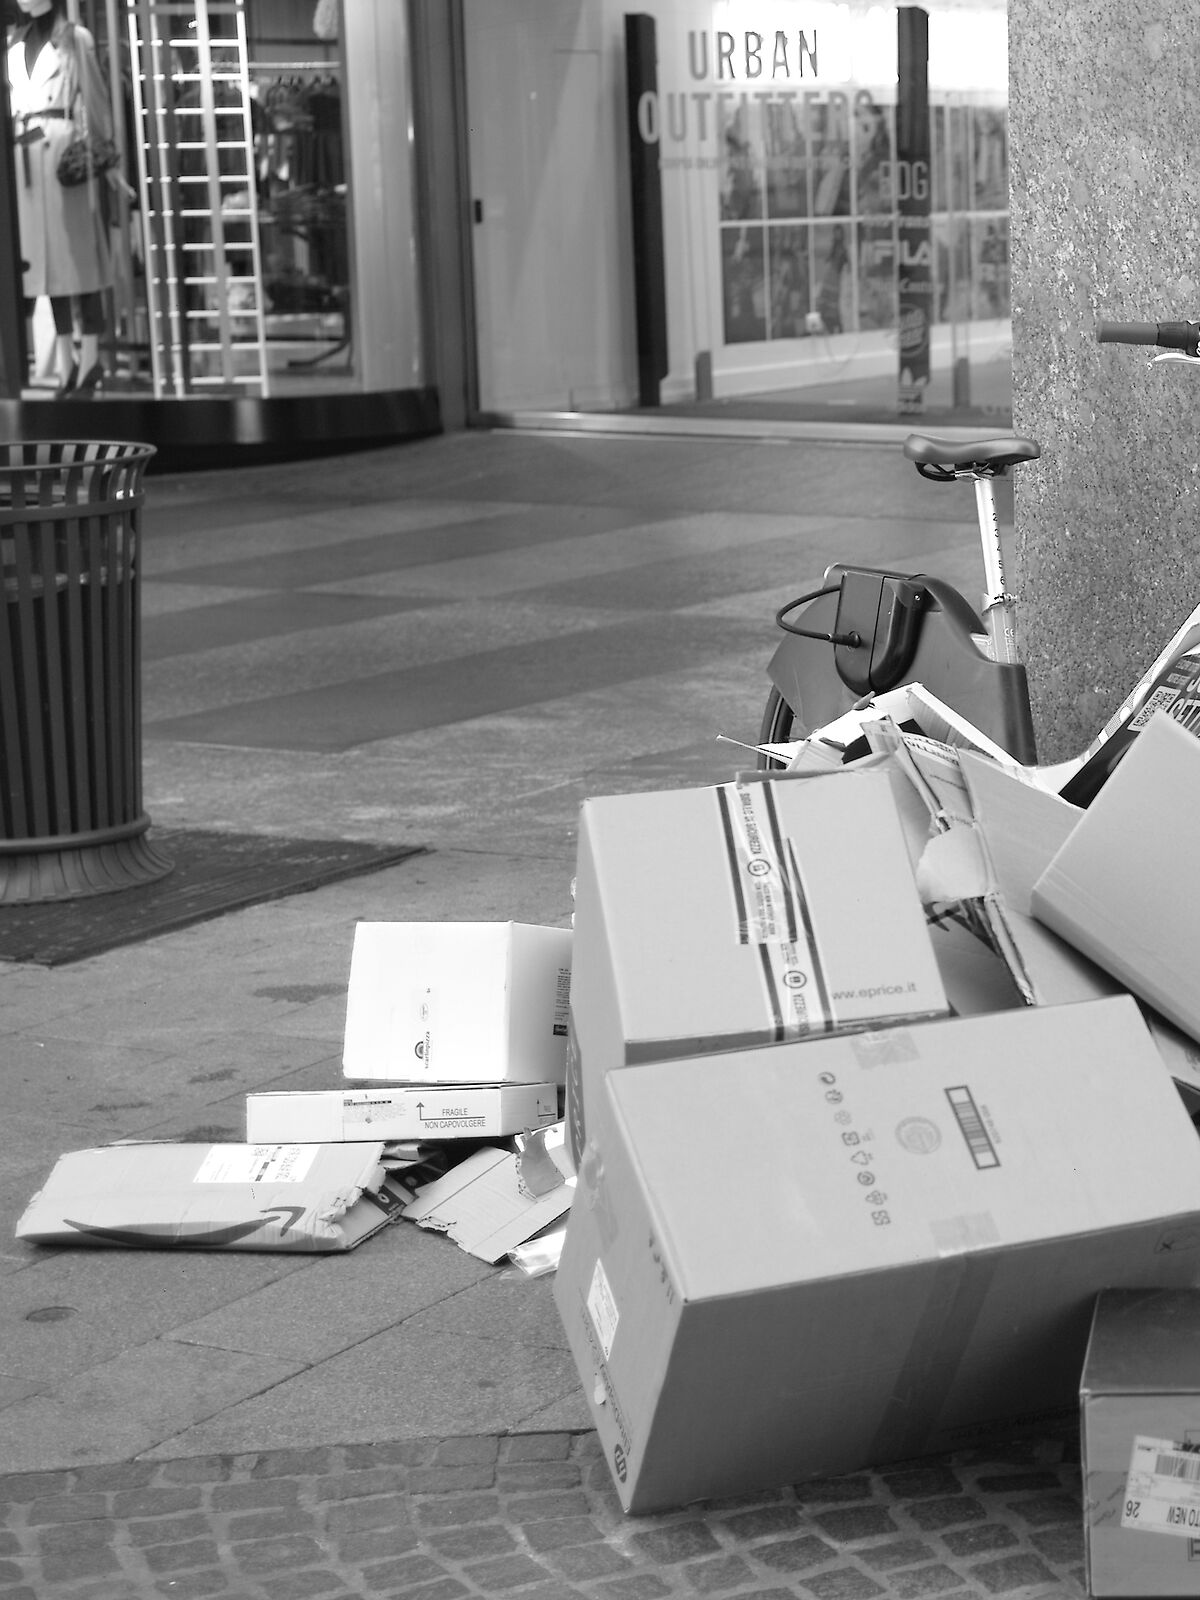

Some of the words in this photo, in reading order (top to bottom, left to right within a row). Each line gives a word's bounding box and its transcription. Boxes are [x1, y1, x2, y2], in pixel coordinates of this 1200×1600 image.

[688, 29, 818, 81] URBAN
[637, 89, 875, 145] OUTFITTERS
[831, 981, 917, 1001] ww.eprice.it
[441, 1107, 469, 1117] FRAGILE
[424, 1120, 441, 1131] NON
[441, 1118, 487, 1130] CAPOVOLGERE
[1125, 1499, 1142, 1519] 26
[1166, 1505, 1188, 1525] NEW
